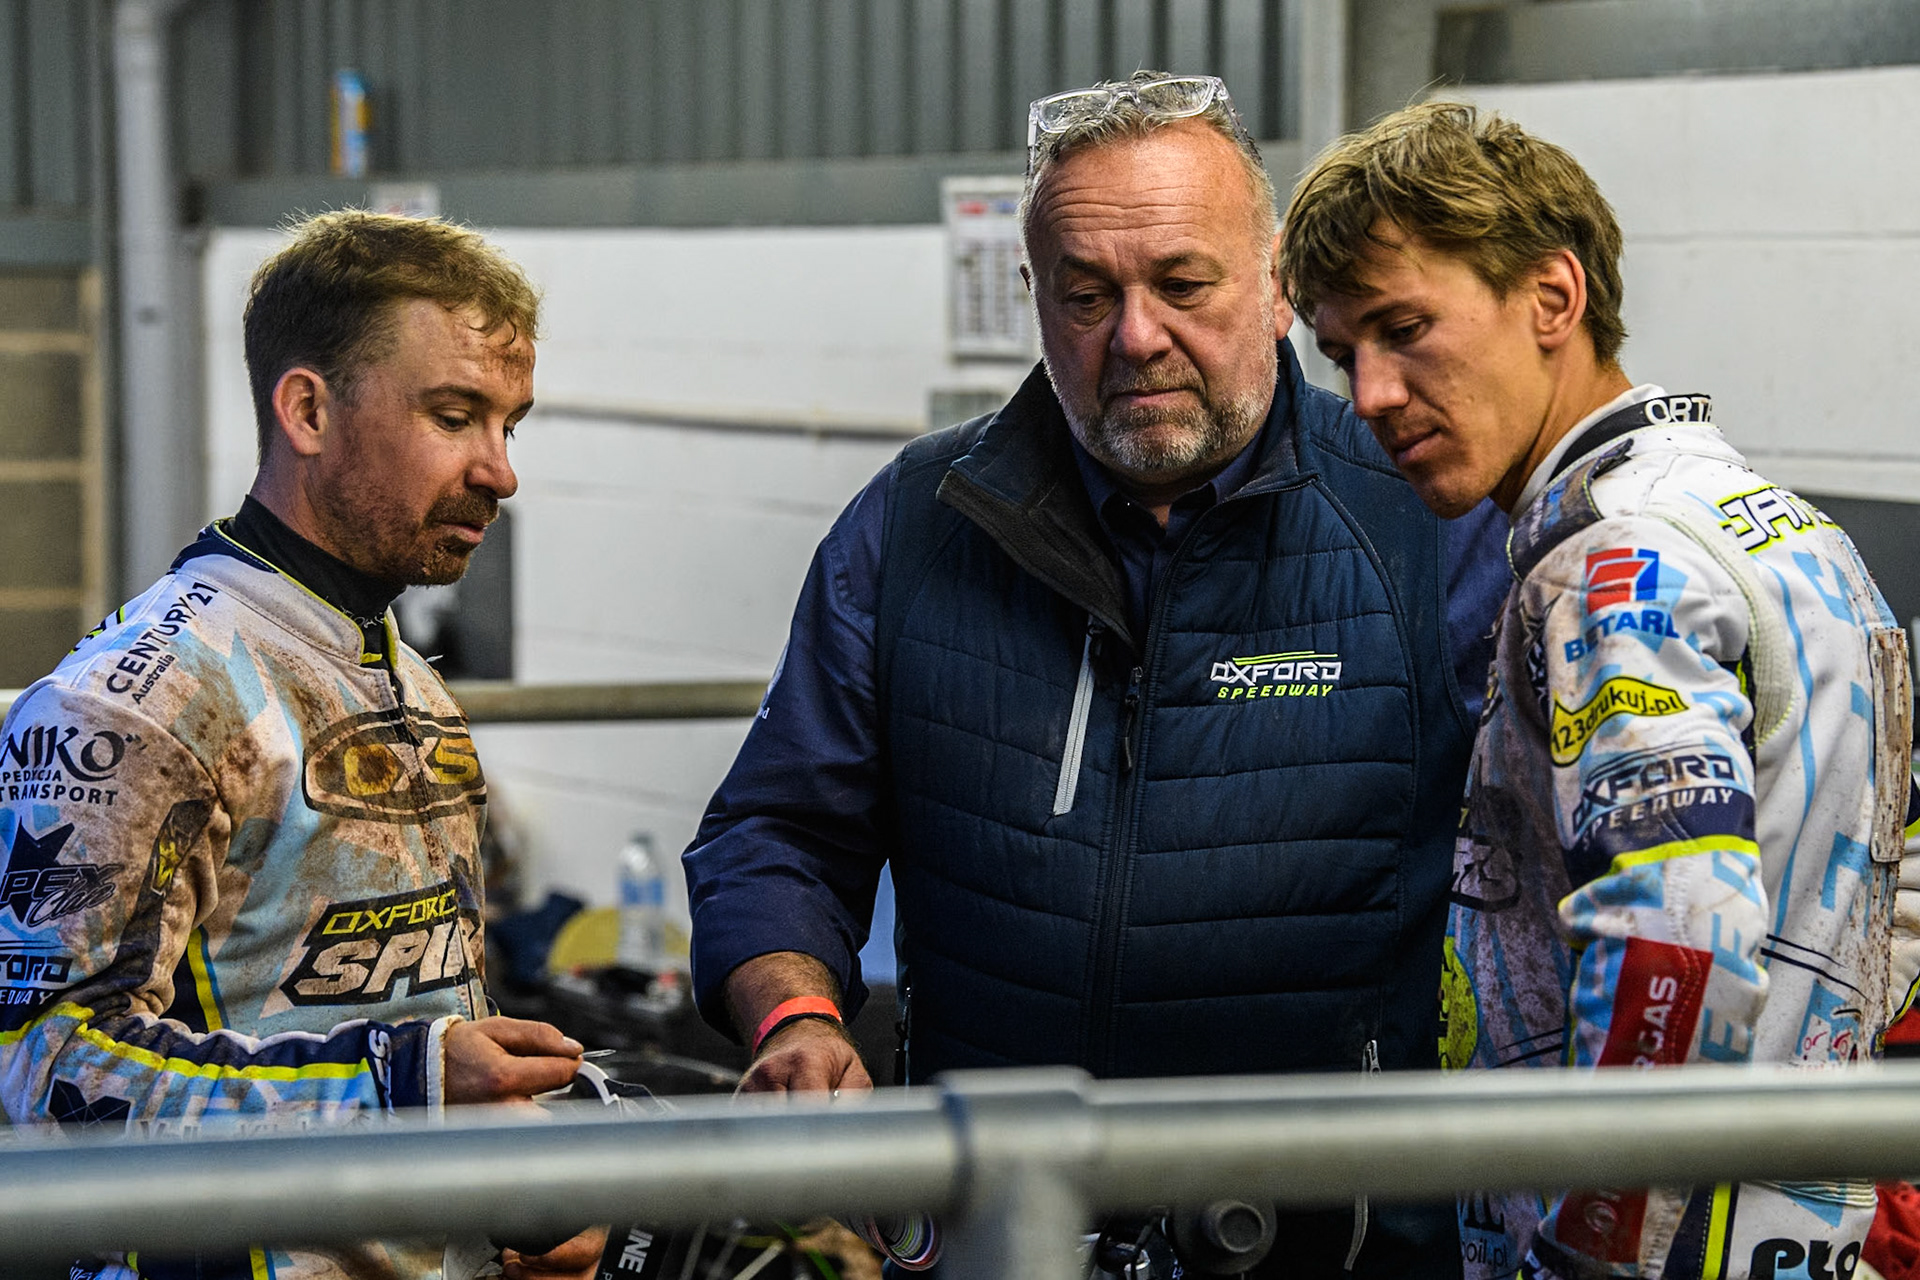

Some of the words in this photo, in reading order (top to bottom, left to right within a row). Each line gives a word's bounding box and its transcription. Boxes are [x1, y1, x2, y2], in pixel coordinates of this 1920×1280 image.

[106, 597, 197, 693] CENTURY
[189, 582, 219, 606] 21
[130, 653, 175, 705] Australia
[1210, 661, 1342, 686] OXFORD
[1218, 684, 1333, 699] SPEEDWAY
[1551, 685, 1679, 753] 123drukuj.pl
[0, 770, 62, 783] PEDYCJA
[343, 736, 479, 797] OXS
[0, 864, 124, 904] PEX
